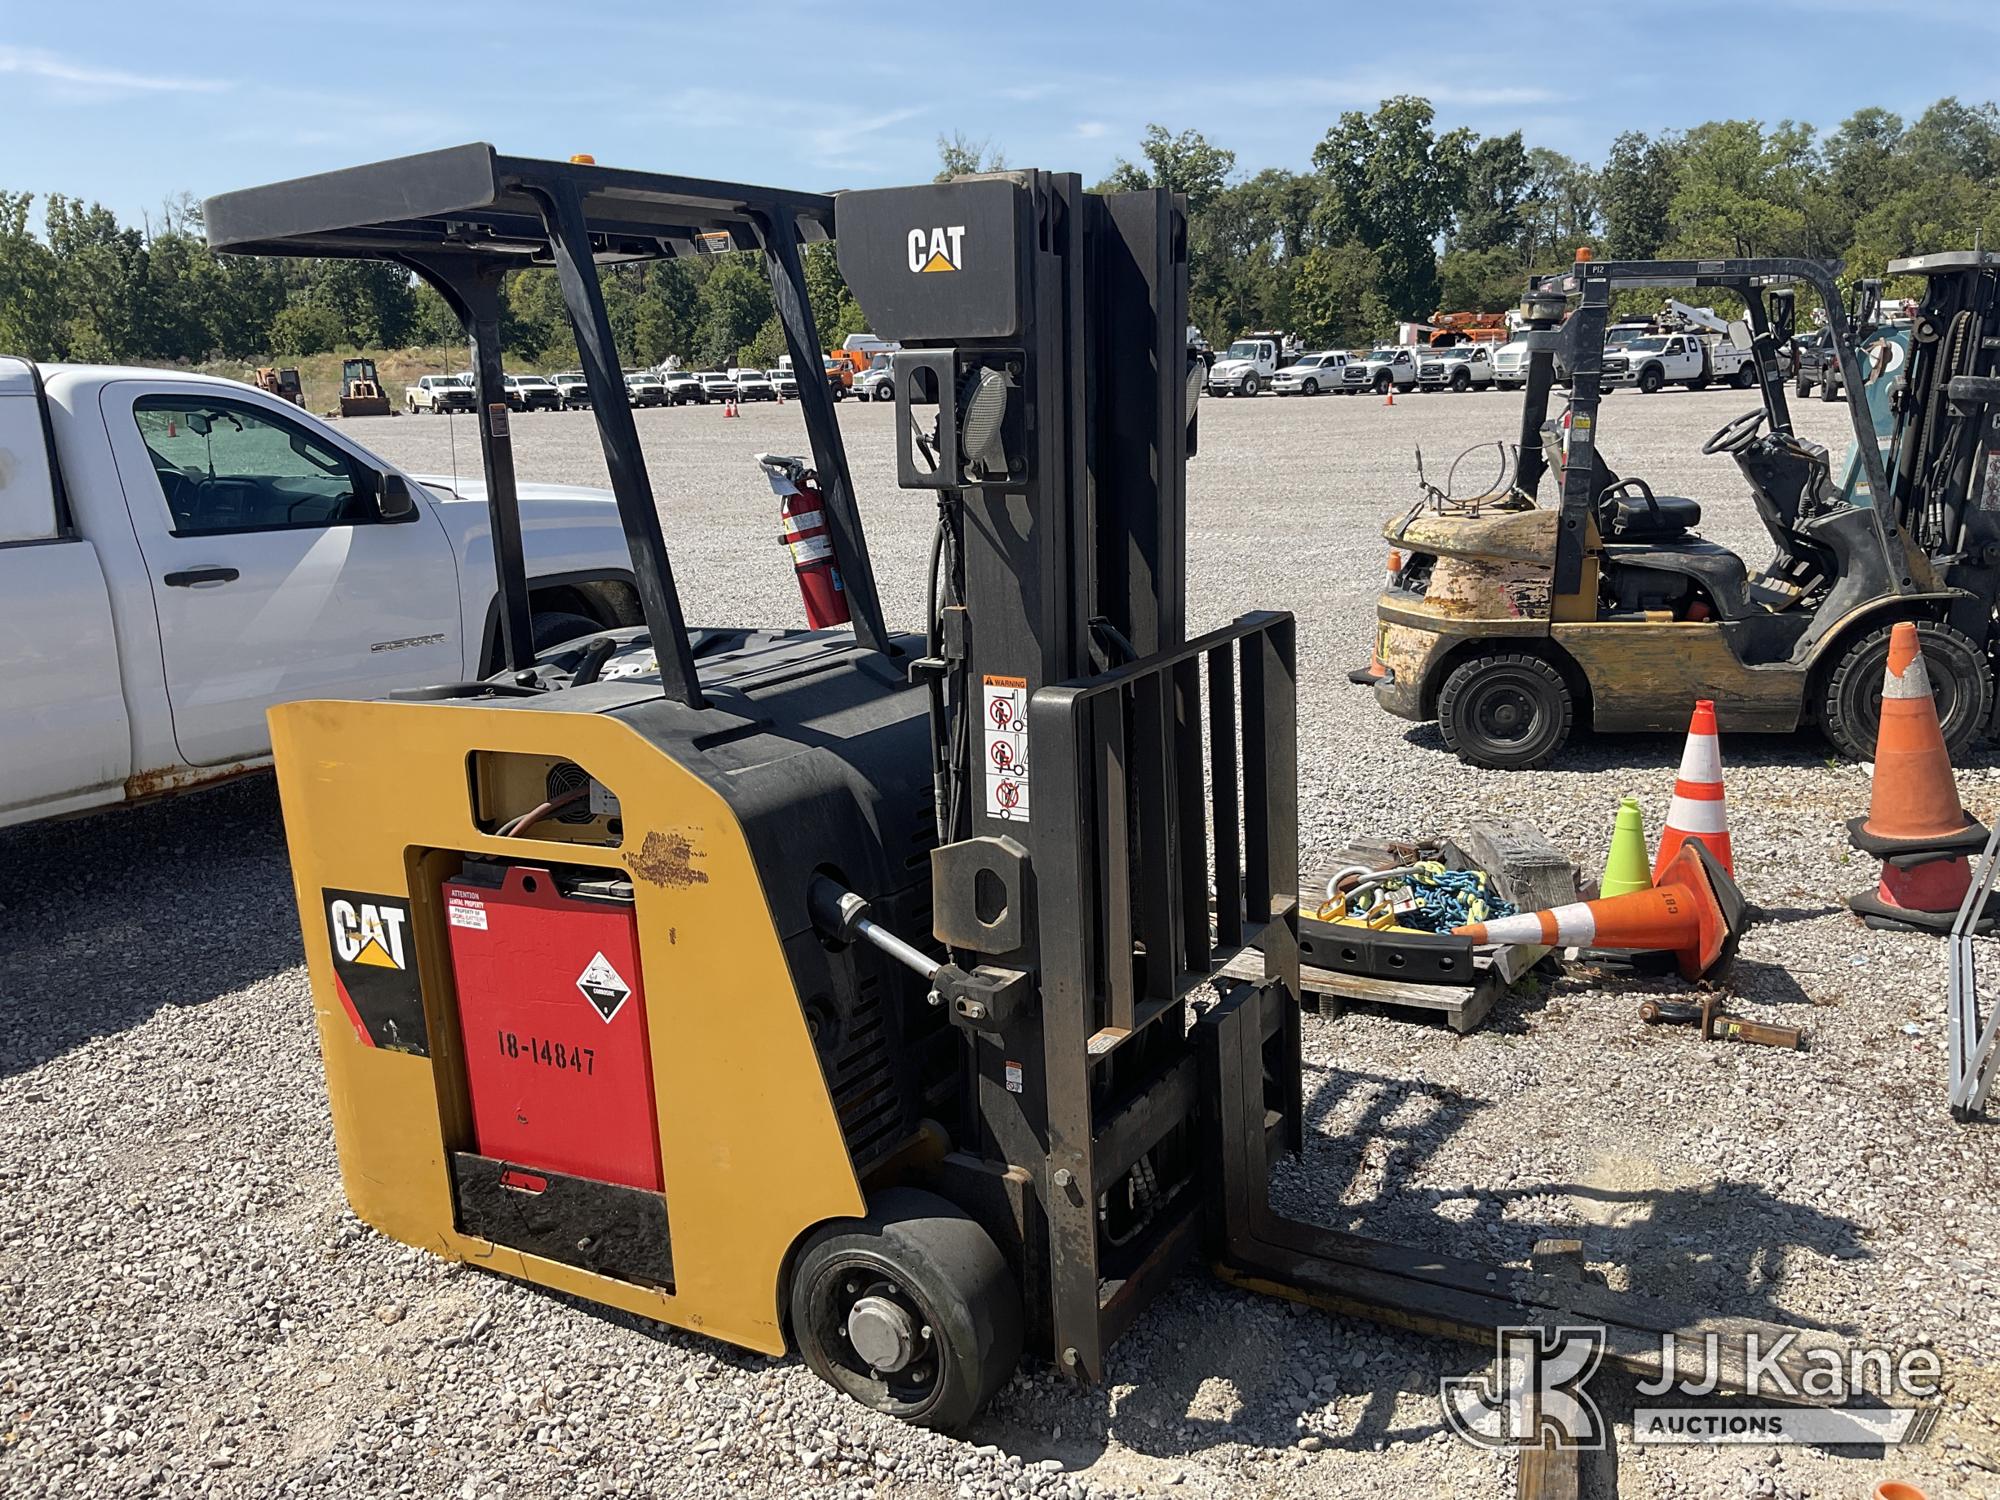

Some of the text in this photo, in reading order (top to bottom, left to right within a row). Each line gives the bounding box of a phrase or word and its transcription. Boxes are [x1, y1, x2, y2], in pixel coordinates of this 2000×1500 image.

[908, 225, 966, 273] CAT
[994, 679, 1026, 689] WARNING
[451, 889, 480, 900] ATTENTION
[464, 900, 484, 909] PROPERTY
[331, 900, 406, 970] CAT
[498, 1031, 594, 1076] 18-14847
